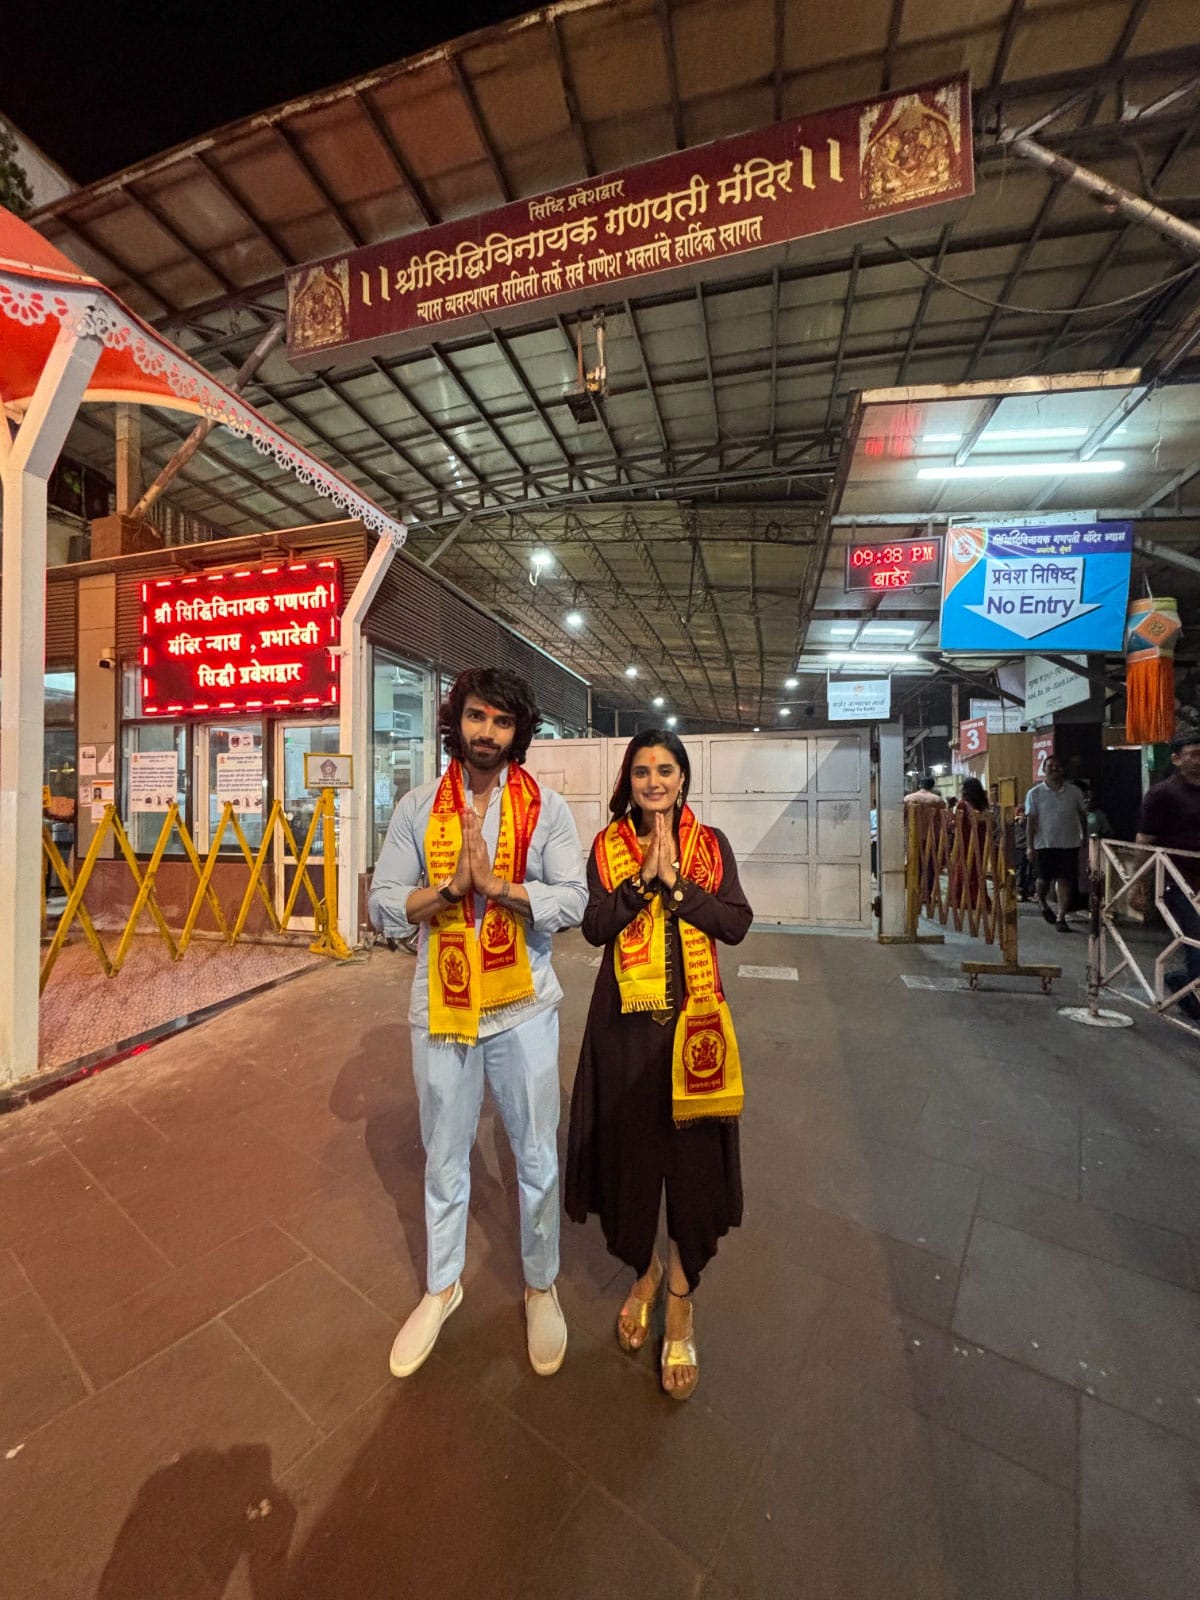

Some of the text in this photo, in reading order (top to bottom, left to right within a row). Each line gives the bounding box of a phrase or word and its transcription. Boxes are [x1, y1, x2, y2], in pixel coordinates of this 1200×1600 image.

[567, 180, 625, 211] प्रवेशद्वार
[604, 174, 710, 237] गणपती
[717, 157, 793, 204] मंदिर
[416, 216, 763, 322] न्यास व्यवस्थापन समिती तर्फे सर्व गणेश भक्तांचे हार्दिक स्वागत
[853, 546, 934, 566] 09:38 PM
[873, 566, 911, 587] बाहेर
[992, 563, 1028, 585] प्रवेश
[154, 602, 172, 624] श्री
[273, 586, 328, 612] गणपती
[987, 595, 1075, 618] No Entry
[168, 633, 203, 655] मंदिर
[205, 634, 242, 652] न्यास
[259, 621, 320, 648] प्रभादेवी
[238, 659, 303, 684] प्रवेशद्वार
[966, 729, 980, 750] 3
[1037, 749, 1048, 777] 2
